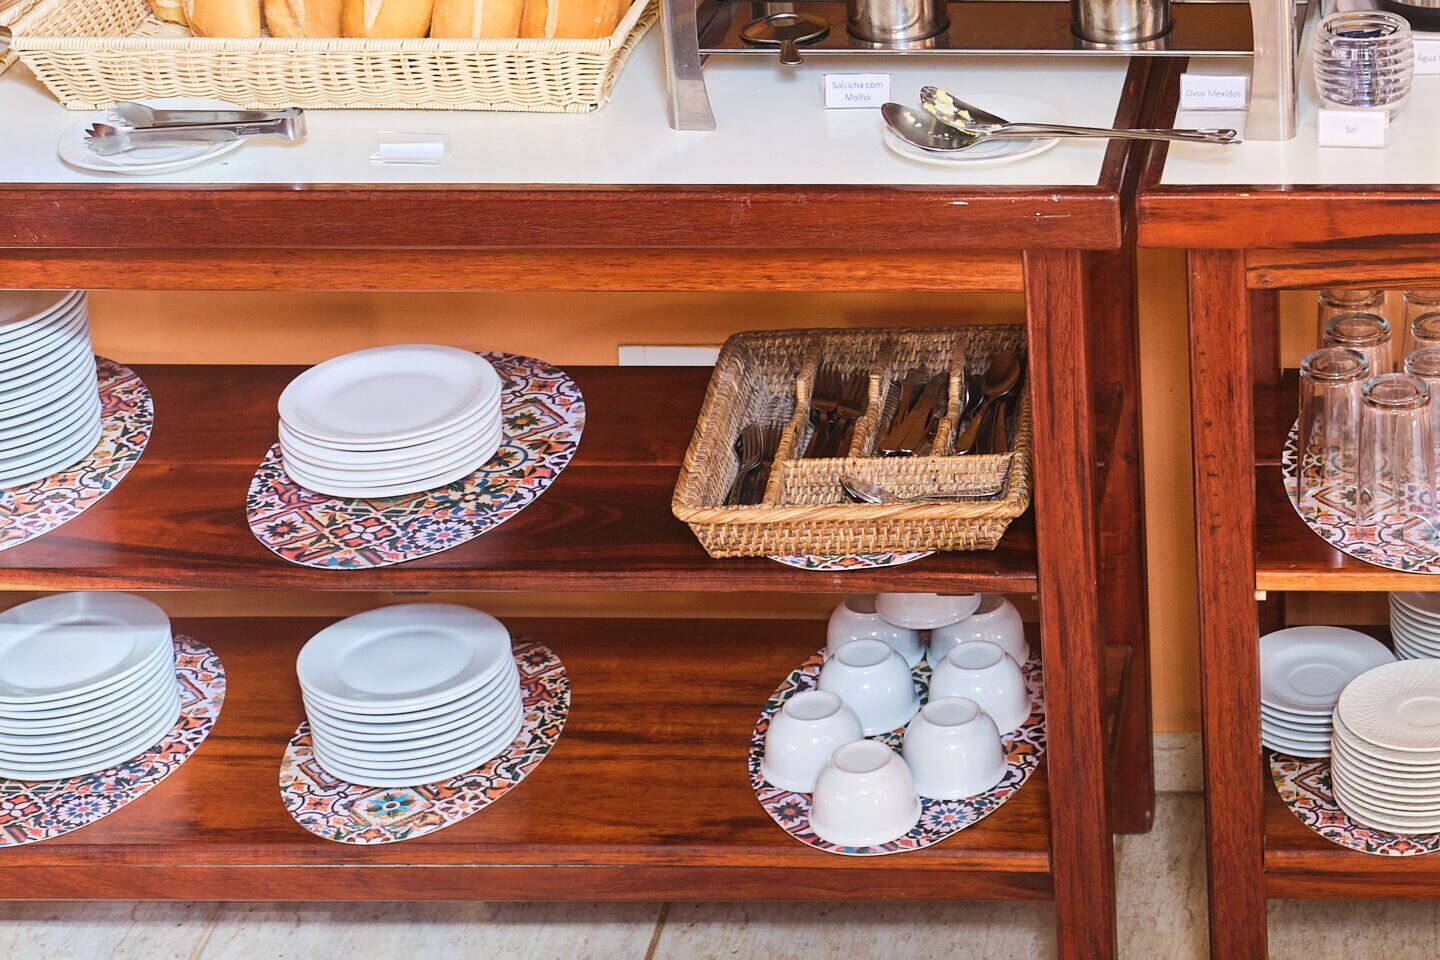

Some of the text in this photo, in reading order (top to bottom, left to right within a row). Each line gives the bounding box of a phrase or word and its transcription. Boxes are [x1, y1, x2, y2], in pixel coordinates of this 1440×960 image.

[1417, 52, 1437, 63] Água
[832, 81, 864, 89] Salsicha
[844, 93, 872, 101] Molho
[1185, 88, 1242, 98] Ovos Mexidos
